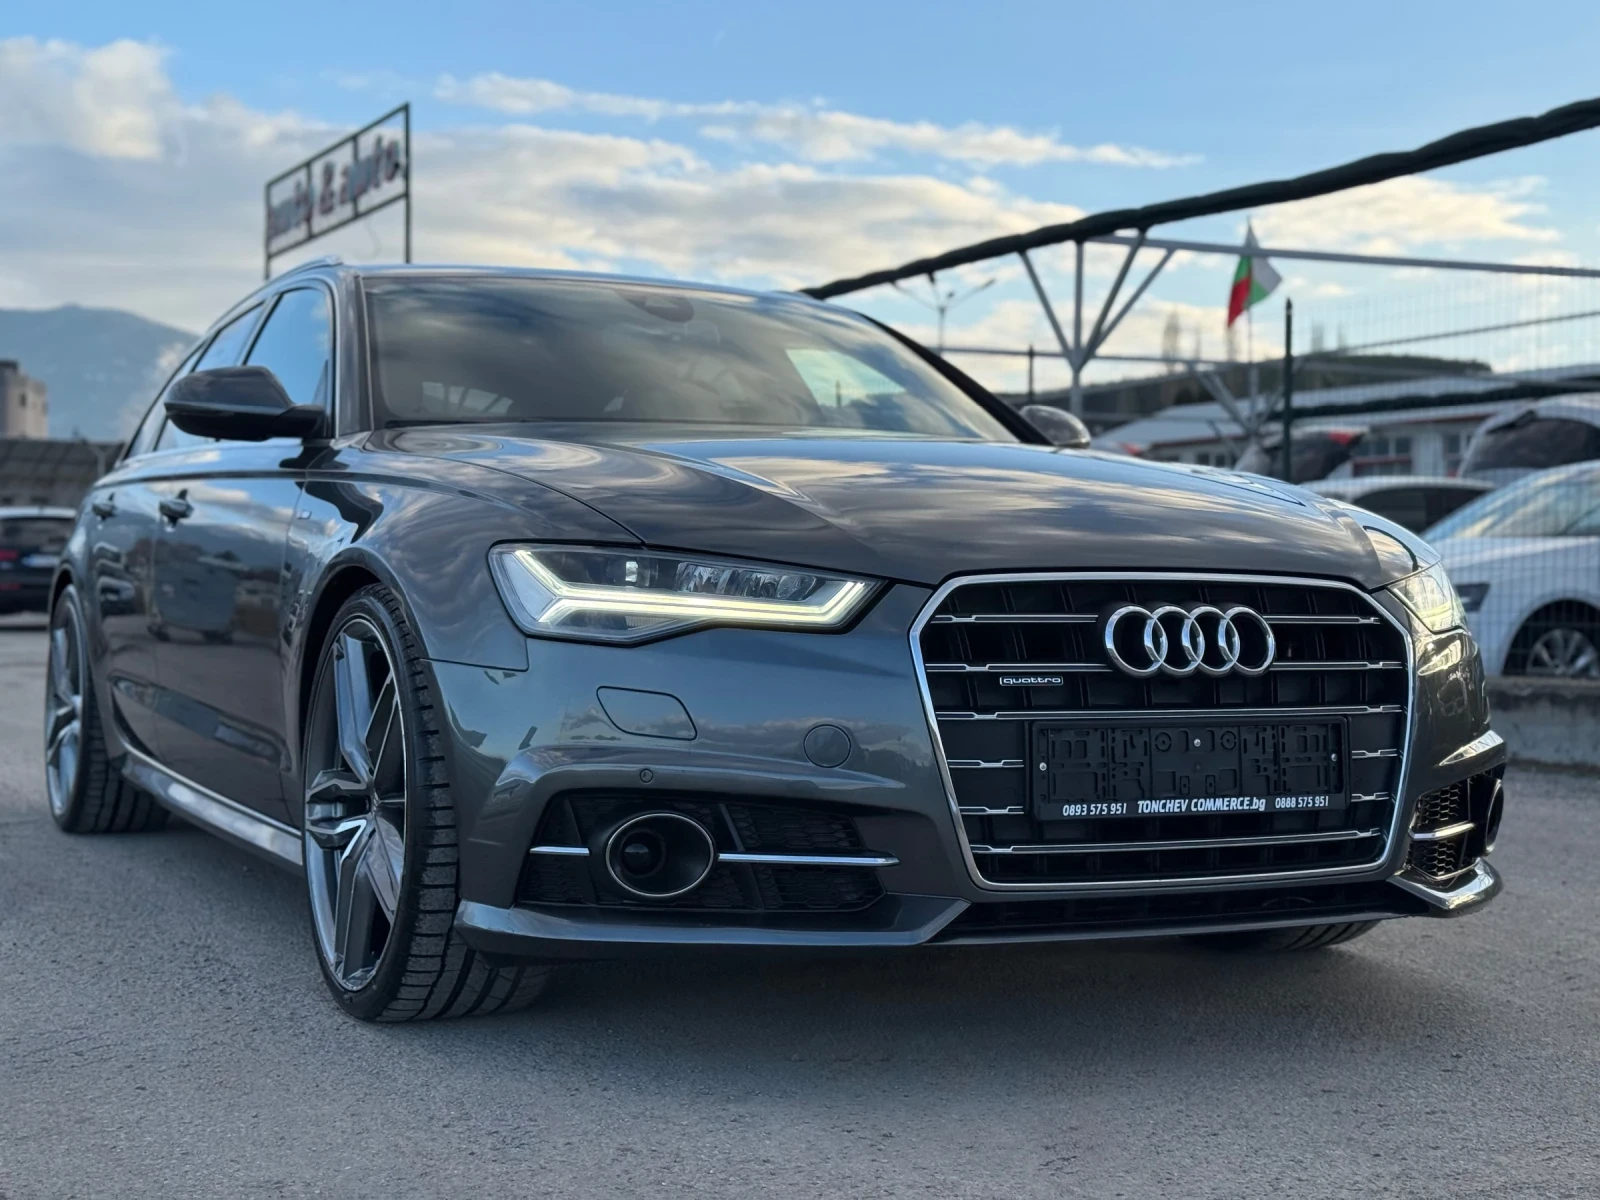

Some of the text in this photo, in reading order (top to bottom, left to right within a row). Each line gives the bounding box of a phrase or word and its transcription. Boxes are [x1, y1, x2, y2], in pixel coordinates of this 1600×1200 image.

[1003, 677, 1061, 685] quattro
[1062, 796, 1329, 816] 0893 575 951 TONCHEV COMMERCE.bg 0888 575 951
